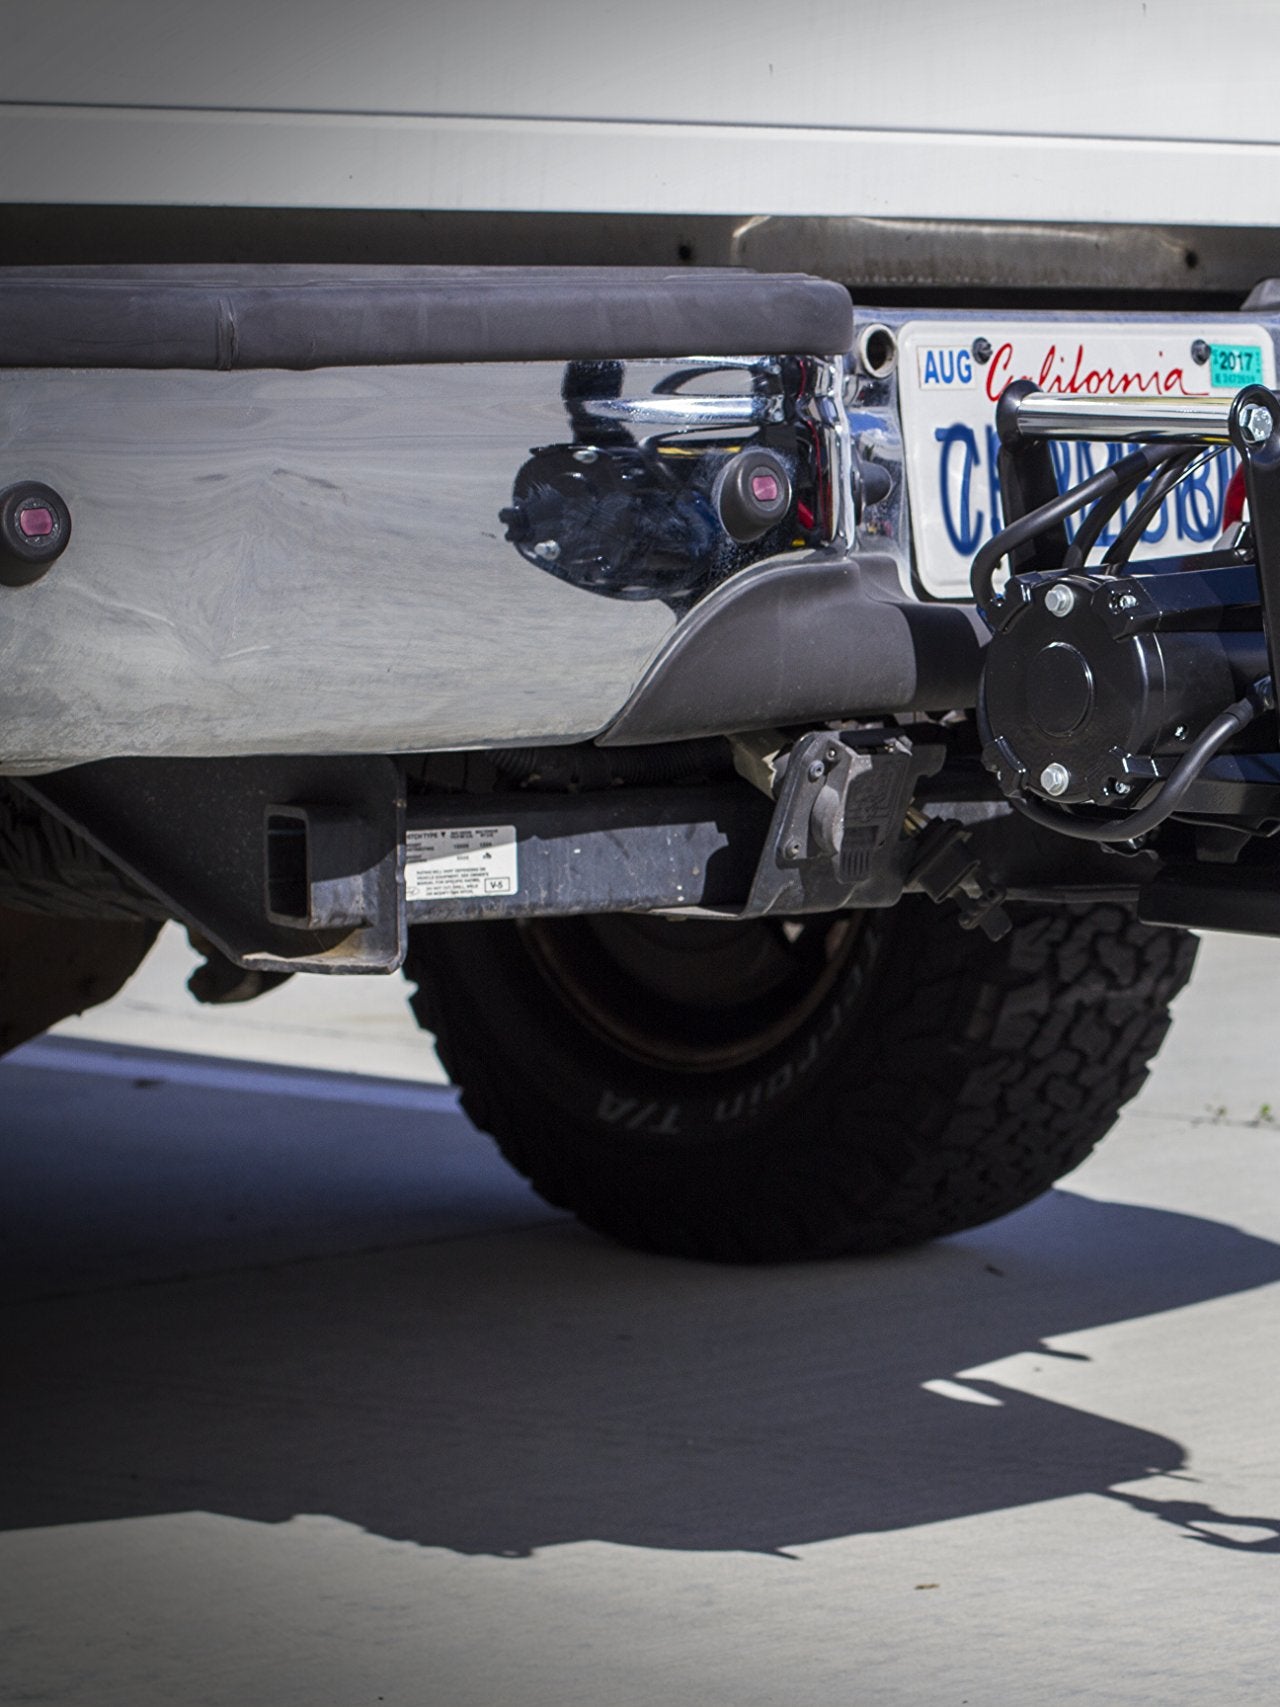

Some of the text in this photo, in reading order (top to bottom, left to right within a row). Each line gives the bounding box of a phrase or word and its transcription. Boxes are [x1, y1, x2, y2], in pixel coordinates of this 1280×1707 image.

[924, 350, 973, 384] AUG
[985, 342, 1209, 402] Clifornia
[1218, 350, 1254, 372] 2017
